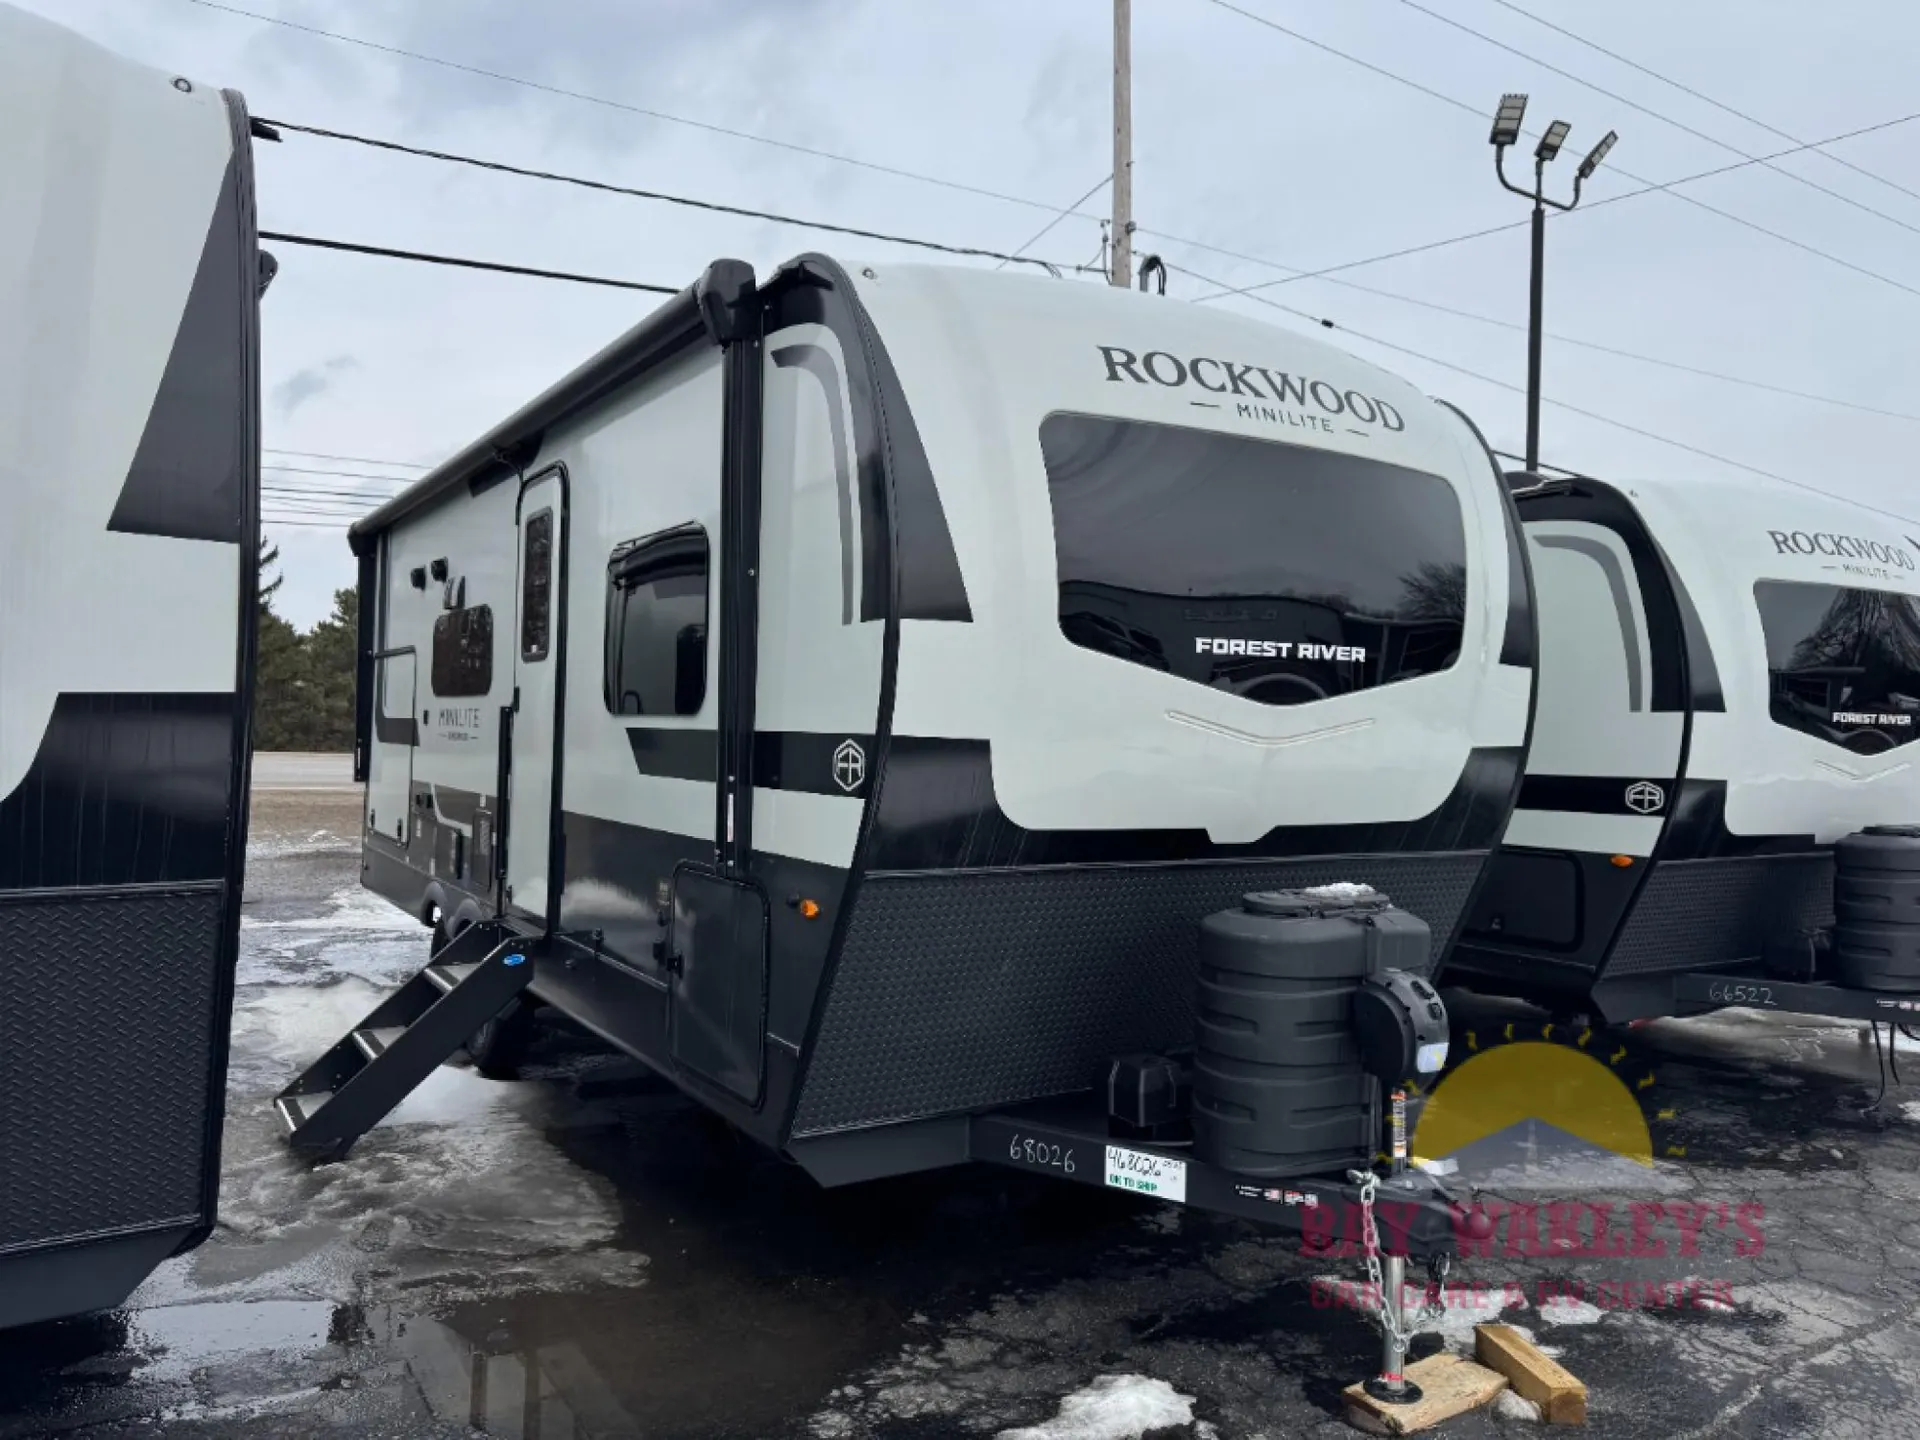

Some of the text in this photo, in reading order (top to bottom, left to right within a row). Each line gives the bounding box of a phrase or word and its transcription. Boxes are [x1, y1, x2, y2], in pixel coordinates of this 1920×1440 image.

[1096, 345, 1405, 432] ROCKWOOD
[1236, 402, 1335, 434] MINILITE
[1766, 530, 1915, 572] ROCKWOOD
[1195, 636, 1366, 663] FOREST RIVER
[1832, 711, 1911, 726] FOREST RIVER
[1010, 1134, 1075, 1172] 68026
